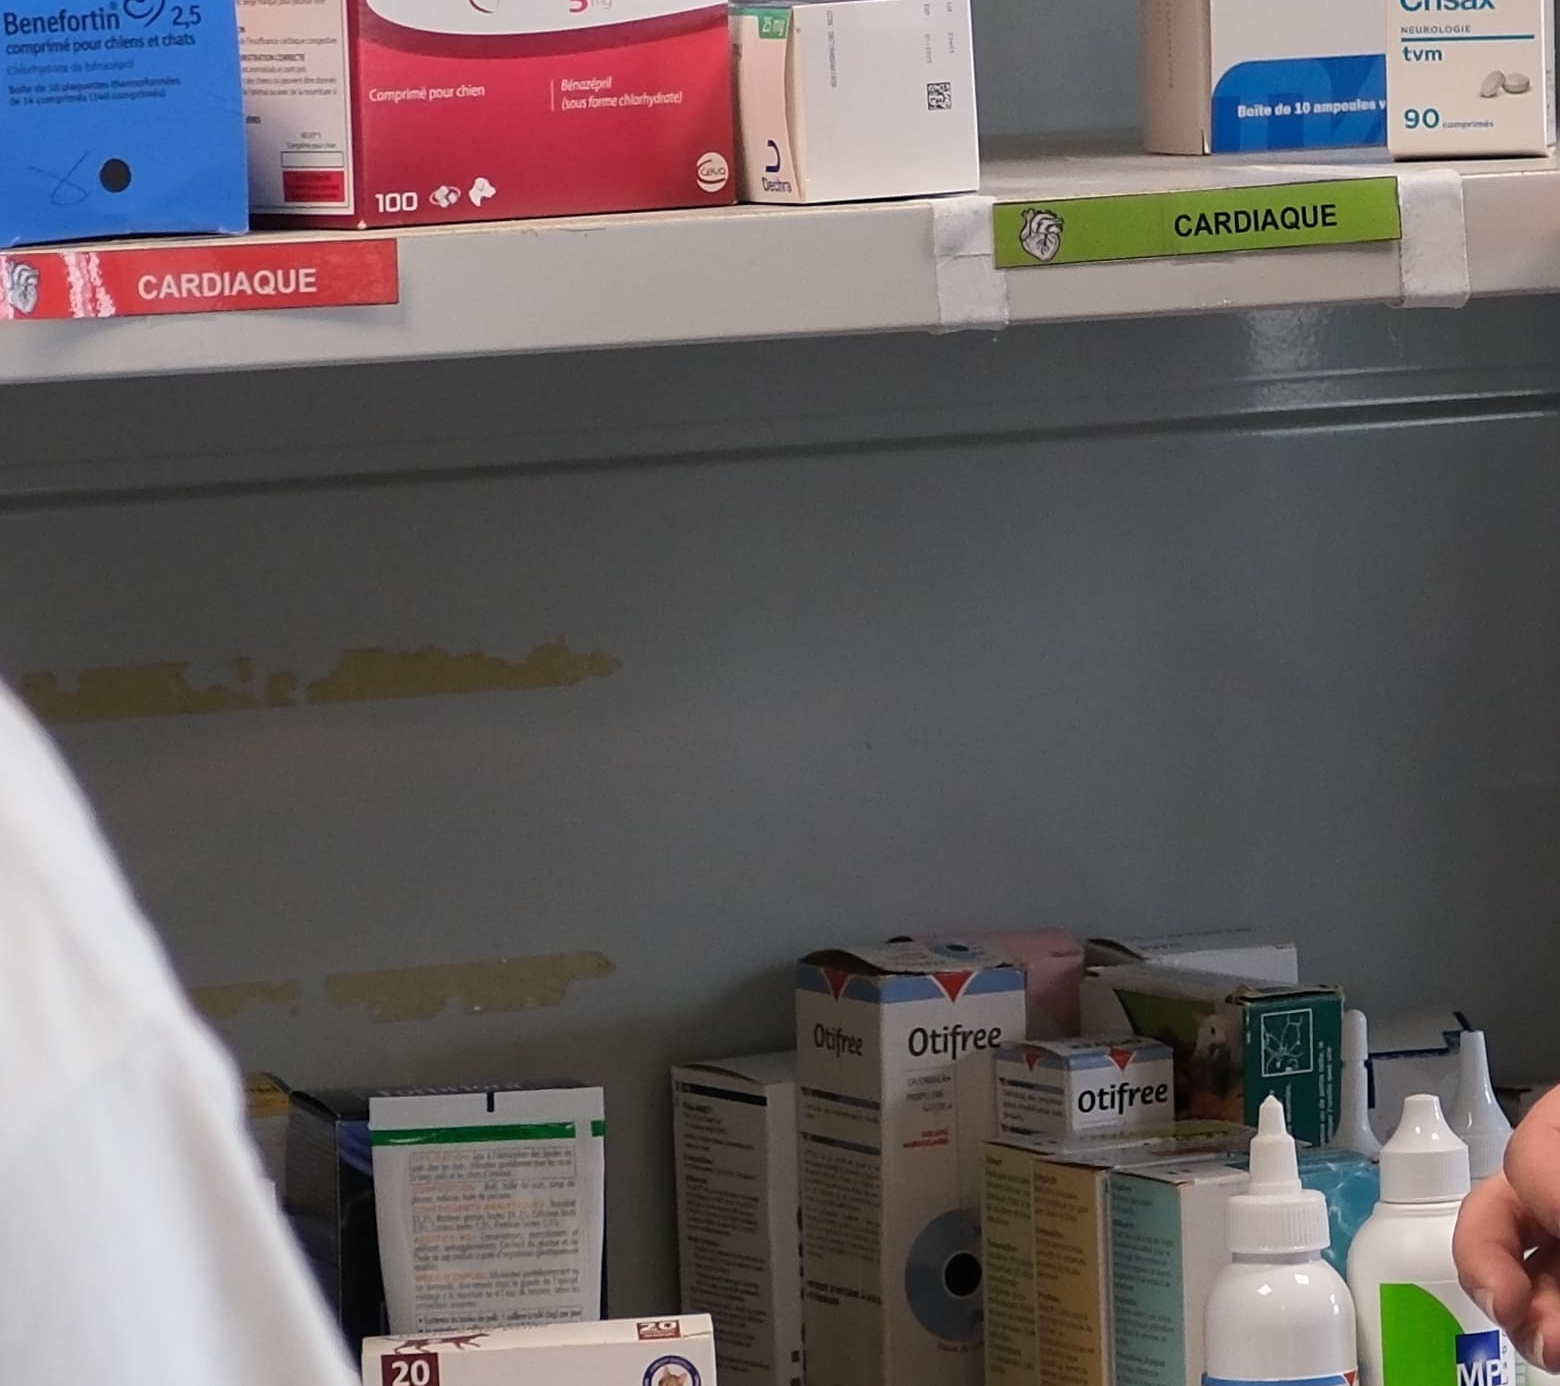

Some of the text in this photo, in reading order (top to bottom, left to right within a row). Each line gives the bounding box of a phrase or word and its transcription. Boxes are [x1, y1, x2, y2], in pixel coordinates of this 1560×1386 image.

[3, 4, 203, 38] Benefortin 2,5
[1400, 24, 1472, 35] NEUROLOGIE
[5, 32, 196, 58] comprimé pour chiens et chats
[1401, 44, 1443, 63] tvm
[368, 83, 486, 104] Comprimé pour chien
[618, 90, 684, 109] chlorhydrate)
[1274, 102, 1292, 117] de
[1293, 100, 1311, 115] 10
[1313, 98, 1377, 116] ampoules
[1403, 108, 1495, 132] 90 comprimés
[374, 191, 419, 214] 100
[1173, 204, 1338, 239] CARDIAQUE
[137, 265, 319, 302] CARDIAQUE
[813, 1022, 864, 1061] Otifree
[907, 1023, 1003, 1061] Otifree
[1076, 1079, 1170, 1117] Otifree
